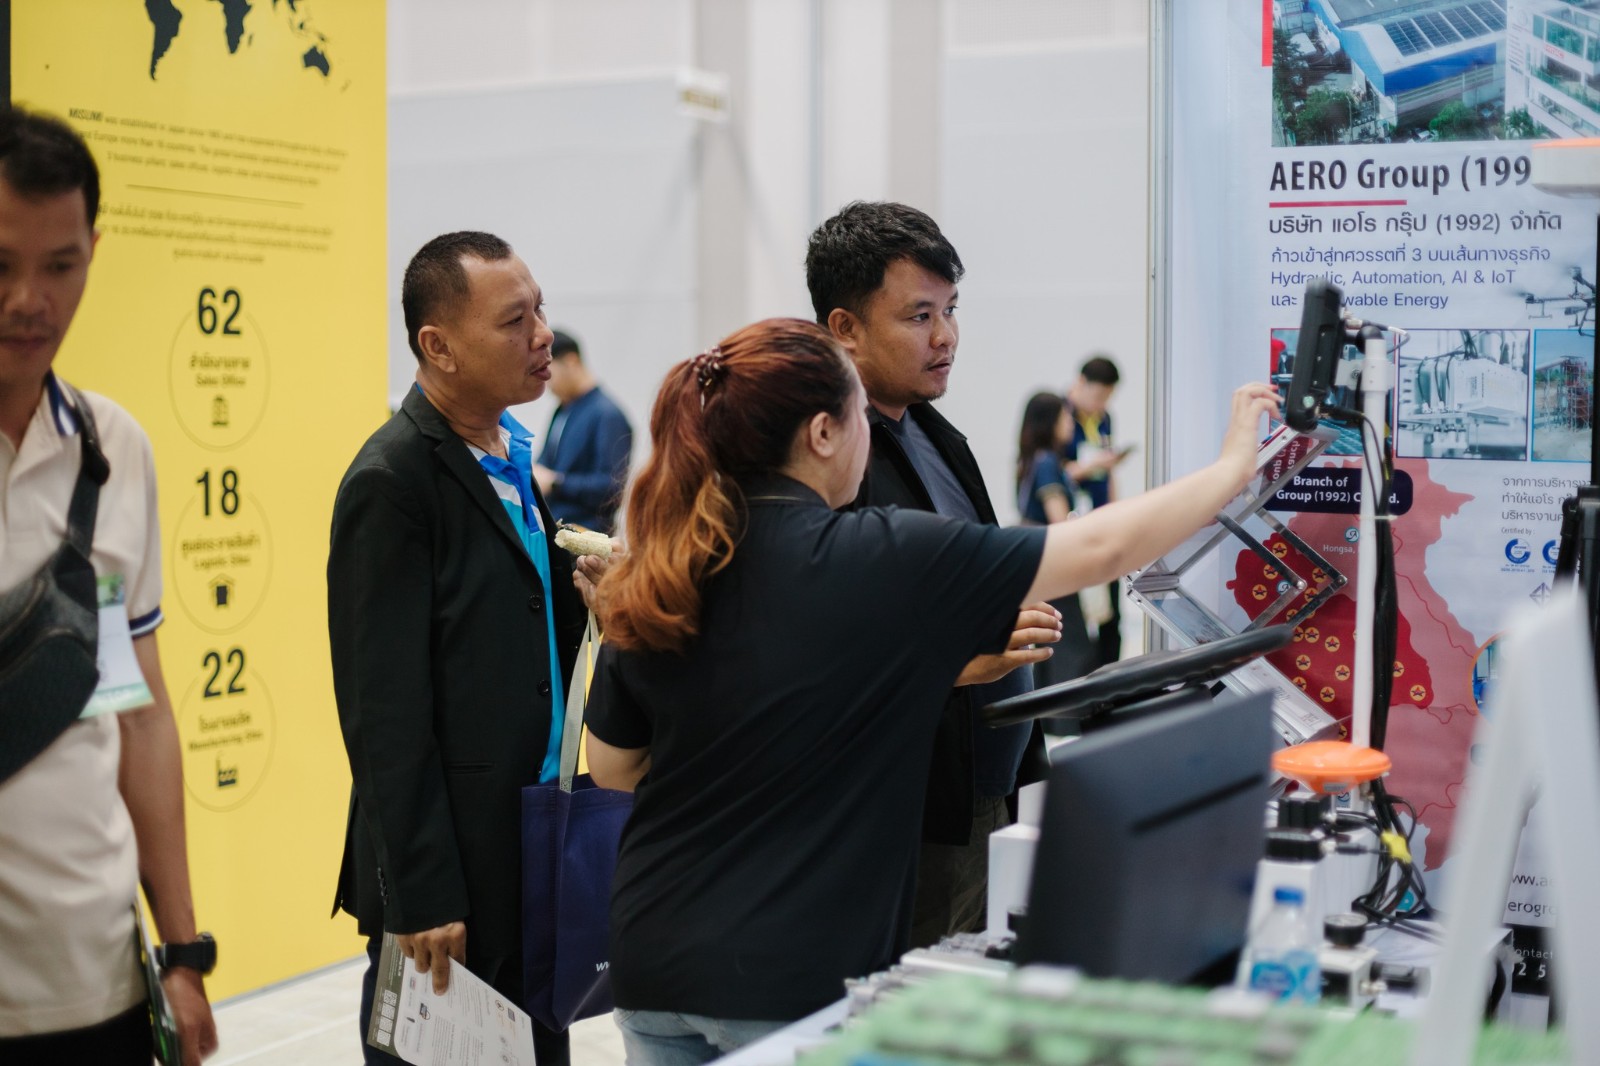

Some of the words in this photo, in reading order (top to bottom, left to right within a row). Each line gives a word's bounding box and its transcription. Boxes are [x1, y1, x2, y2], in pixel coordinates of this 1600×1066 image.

[1269, 159, 1347, 191] AERO
[1357, 158, 1450, 195] Group
[1460, 155, 1532, 192] (199
[1269, 214, 1322, 234] บริษัท
[1332, 210, 1377, 233] แอโร
[1386, 211, 1427, 237] กรุ๊ป
[1436, 212, 1501, 236] (1992)
[1510, 210, 1562, 231] จำกัด
[1412, 247, 1422, 262] 3
[1352, 270, 1446, 287] Automation,
[1473, 269, 1485, 284] &
[1491, 269, 1516, 284] IoT
[1271, 294, 1298, 307] และ
[1344, 292, 1388, 307] wable
[1394, 292, 1449, 310] Energy
[198, 288, 241, 335] 62
[1293, 475, 1333, 487] Branch
[1335, 476, 1348, 487] of
[196, 469, 239, 516] 18
[1276, 489, 1312, 503] Group
[1314, 490, 1351, 503] (1992)
[1323, 544, 1355, 554] Hongsa,
[203, 648, 246, 698] 22
[1515, 948, 1553, 959] ontact
